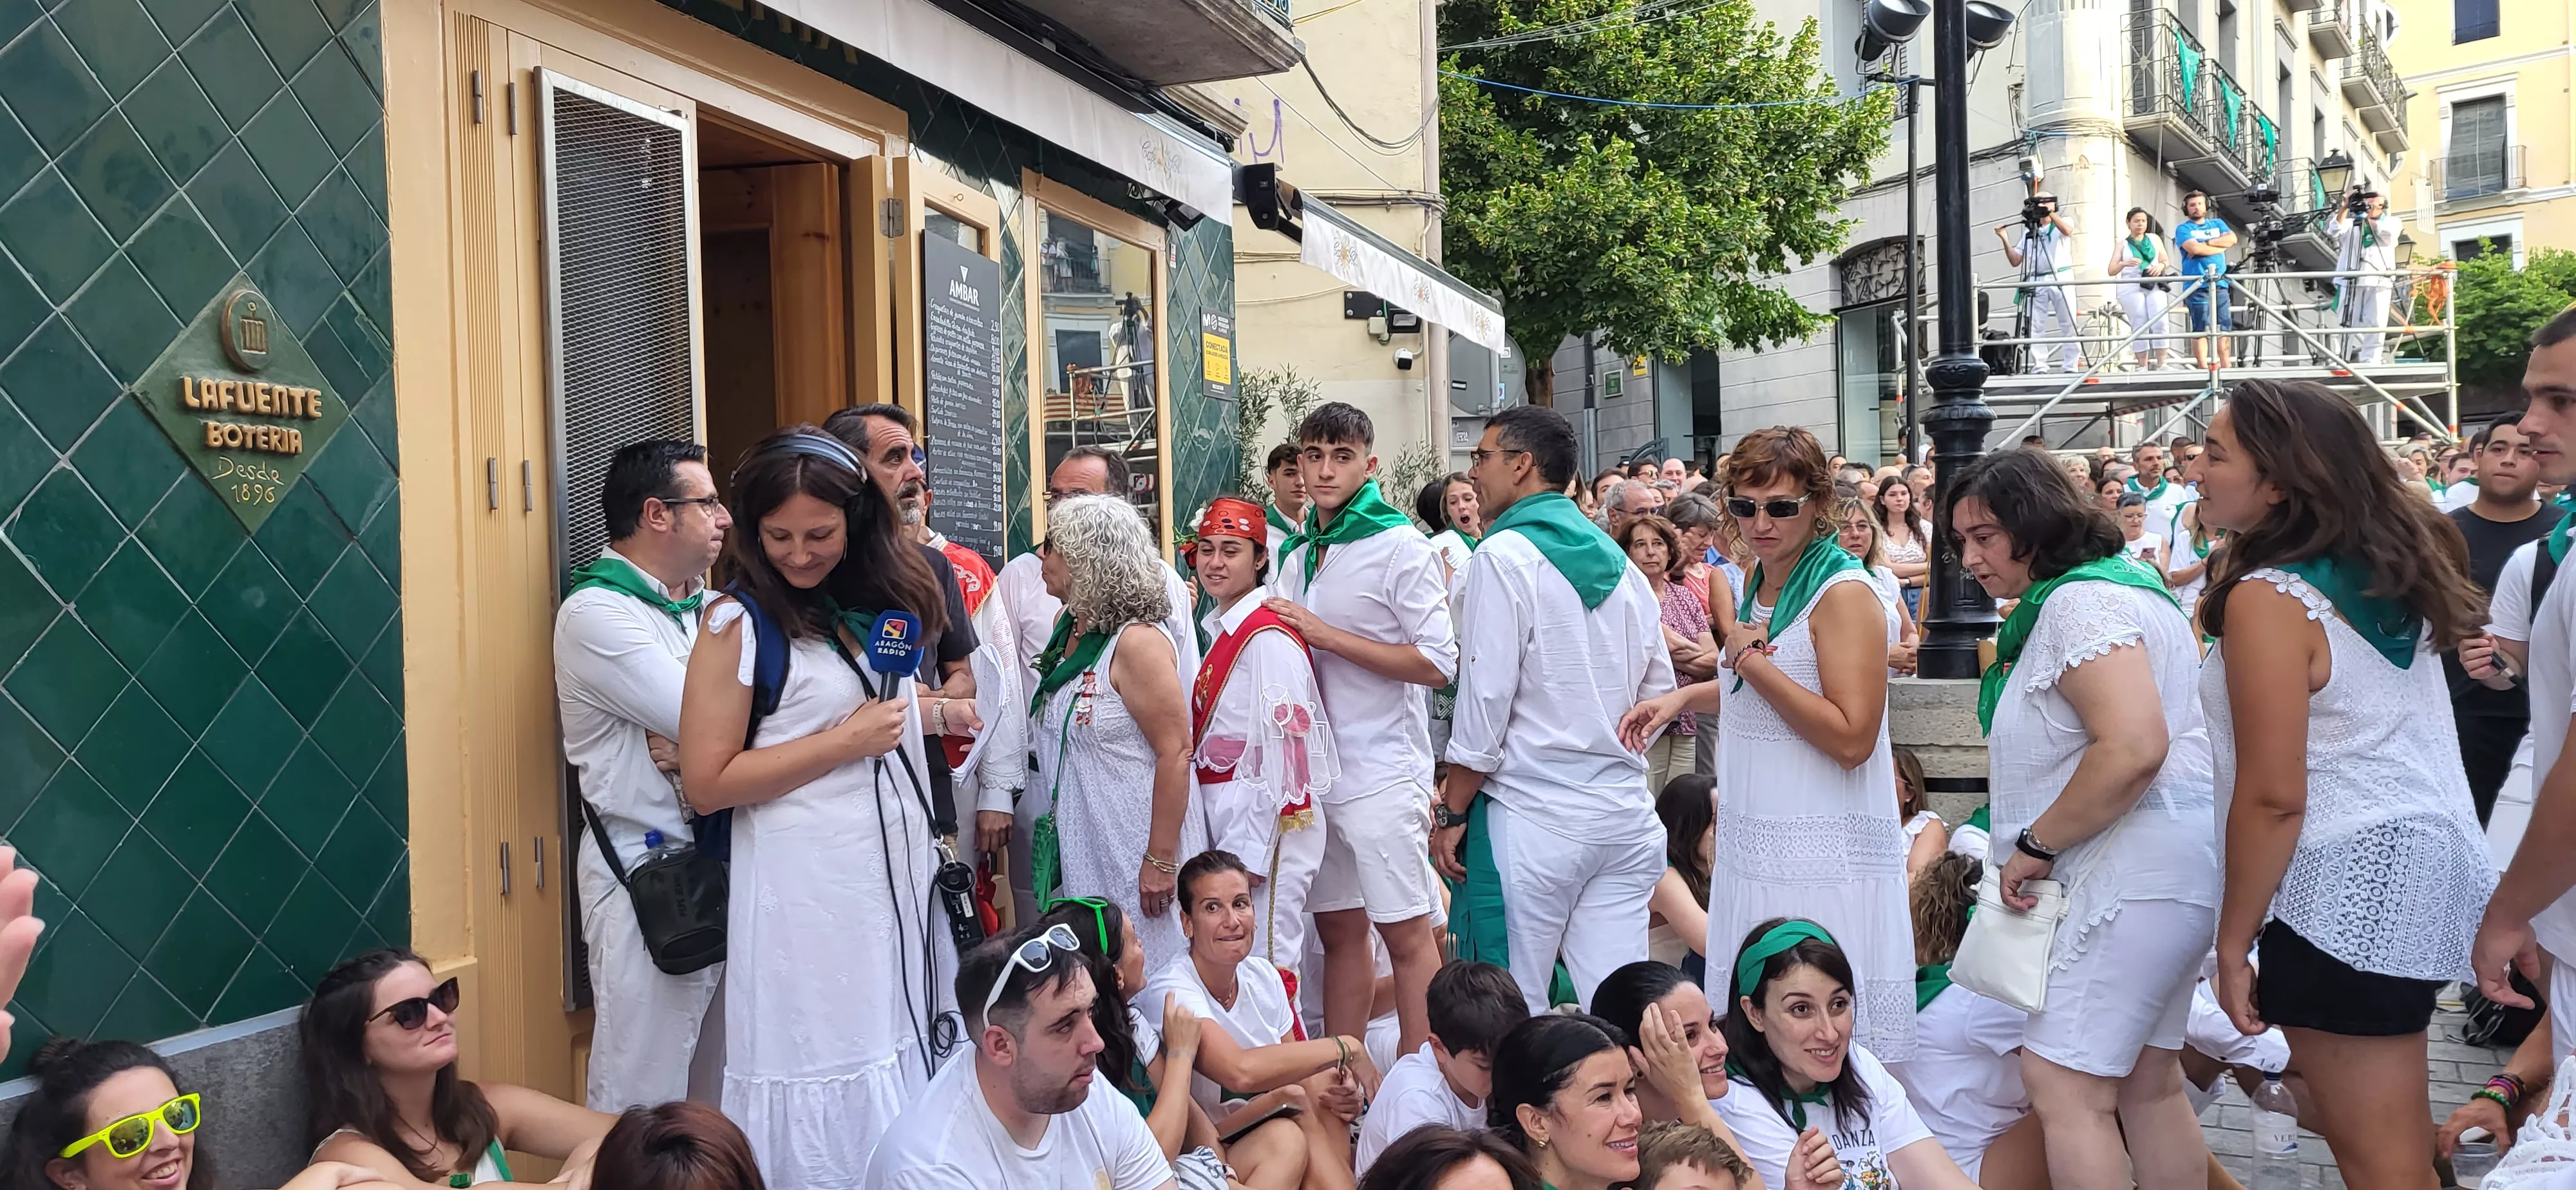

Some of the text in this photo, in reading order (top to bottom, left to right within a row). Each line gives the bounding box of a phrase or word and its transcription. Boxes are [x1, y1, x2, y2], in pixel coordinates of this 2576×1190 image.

[949, 279, 980, 307] AMBAR
[1206, 341, 1227, 353] CONECTADA
[184, 377, 322, 417] LAFUENTE
[206, 422, 302, 453] BOTERIA
[212, 456, 284, 485] Desde
[231, 484, 275, 505] 1896
[874, 640, 913, 651] ARAGÓN
[877, 647, 906, 657] RADIO
[1832, 1129, 1875, 1150] DANZA
